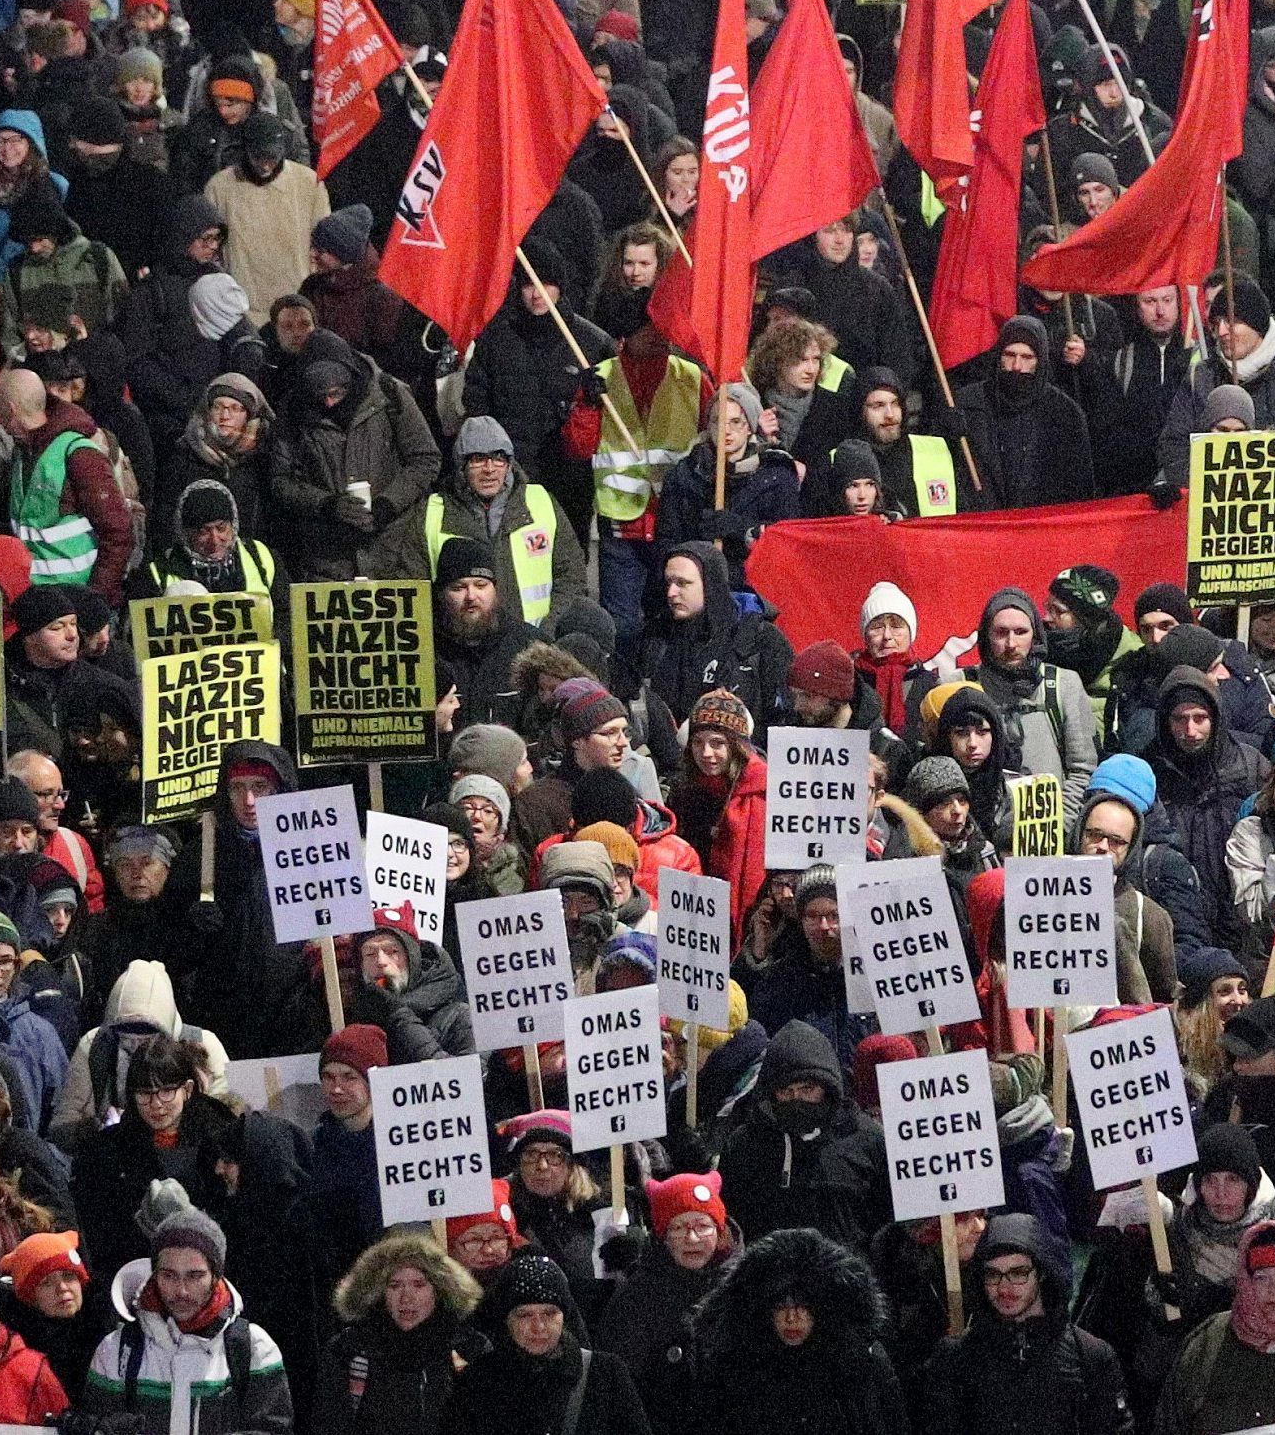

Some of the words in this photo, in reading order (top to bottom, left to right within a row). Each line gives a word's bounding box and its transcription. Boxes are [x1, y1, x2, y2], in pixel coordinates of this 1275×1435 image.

[396, 149, 444, 232] KSV
[1200, 563, 1233, 581] UND
[144, 599, 255, 637] LASST
[306, 588, 417, 621] LASST
[307, 621, 420, 654] NAZIS
[158, 649, 265, 693] LASST
[309, 654, 420, 688] NICHT
[158, 677, 264, 723] NAZIS
[310, 687, 421, 710] REGIEREN
[158, 707, 264, 754] NICHT
[312, 717, 348, 734] UND
[351, 716, 424, 733] NIEMALS
[312, 733, 425, 748] AUFMARSCHIEREN!
[786, 746, 851, 766] OMAS
[157, 778, 191, 796] UND
[778, 781, 856, 800] GEGEN
[1016, 783, 1058, 822] LASST
[276, 807, 338, 833] OMAS
[771, 815, 861, 834] RECHTS
[381, 833, 433, 860] OMAS
[1017, 820, 1059, 856] NAZIS
[275, 844, 351, 869] GEGEN
[275, 877, 363, 905] RECHTS
[374, 866, 436, 896] GEGEN
[1024, 876, 1093, 897] OMAS
[670, 889, 716, 918] OMAS
[870, 896, 934, 925] OMAS
[477, 912, 544, 939] OMAS
[1018, 913, 1102, 934] GEGEN
[665, 924, 721, 954] GEGEN
[872, 931, 950, 962] GEGEN
[476, 948, 556, 975] GEGEN
[1013, 949, 1109, 969] RECHTS
[661, 960, 725, 992] RECHTS
[876, 966, 965, 999] RECHTS
[474, 982, 569, 1013] RECHTS
[580, 1009, 642, 1036] OMAS
[577, 1044, 651, 1075] GEGEN
[1089, 1036, 1157, 1070] OMAS
[392, 1079, 462, 1106] OMAS
[573, 1080, 659, 1112] RECHTS
[899, 1074, 971, 1102] OMAS
[1090, 1071, 1171, 1108] GEGEN
[388, 1116, 474, 1146] GEGEN
[897, 1110, 983, 1140] GEGEN
[1090, 1106, 1185, 1147] RECHTS
[384, 1153, 483, 1185] RECHTS
[895, 1148, 994, 1180] RECHTS
